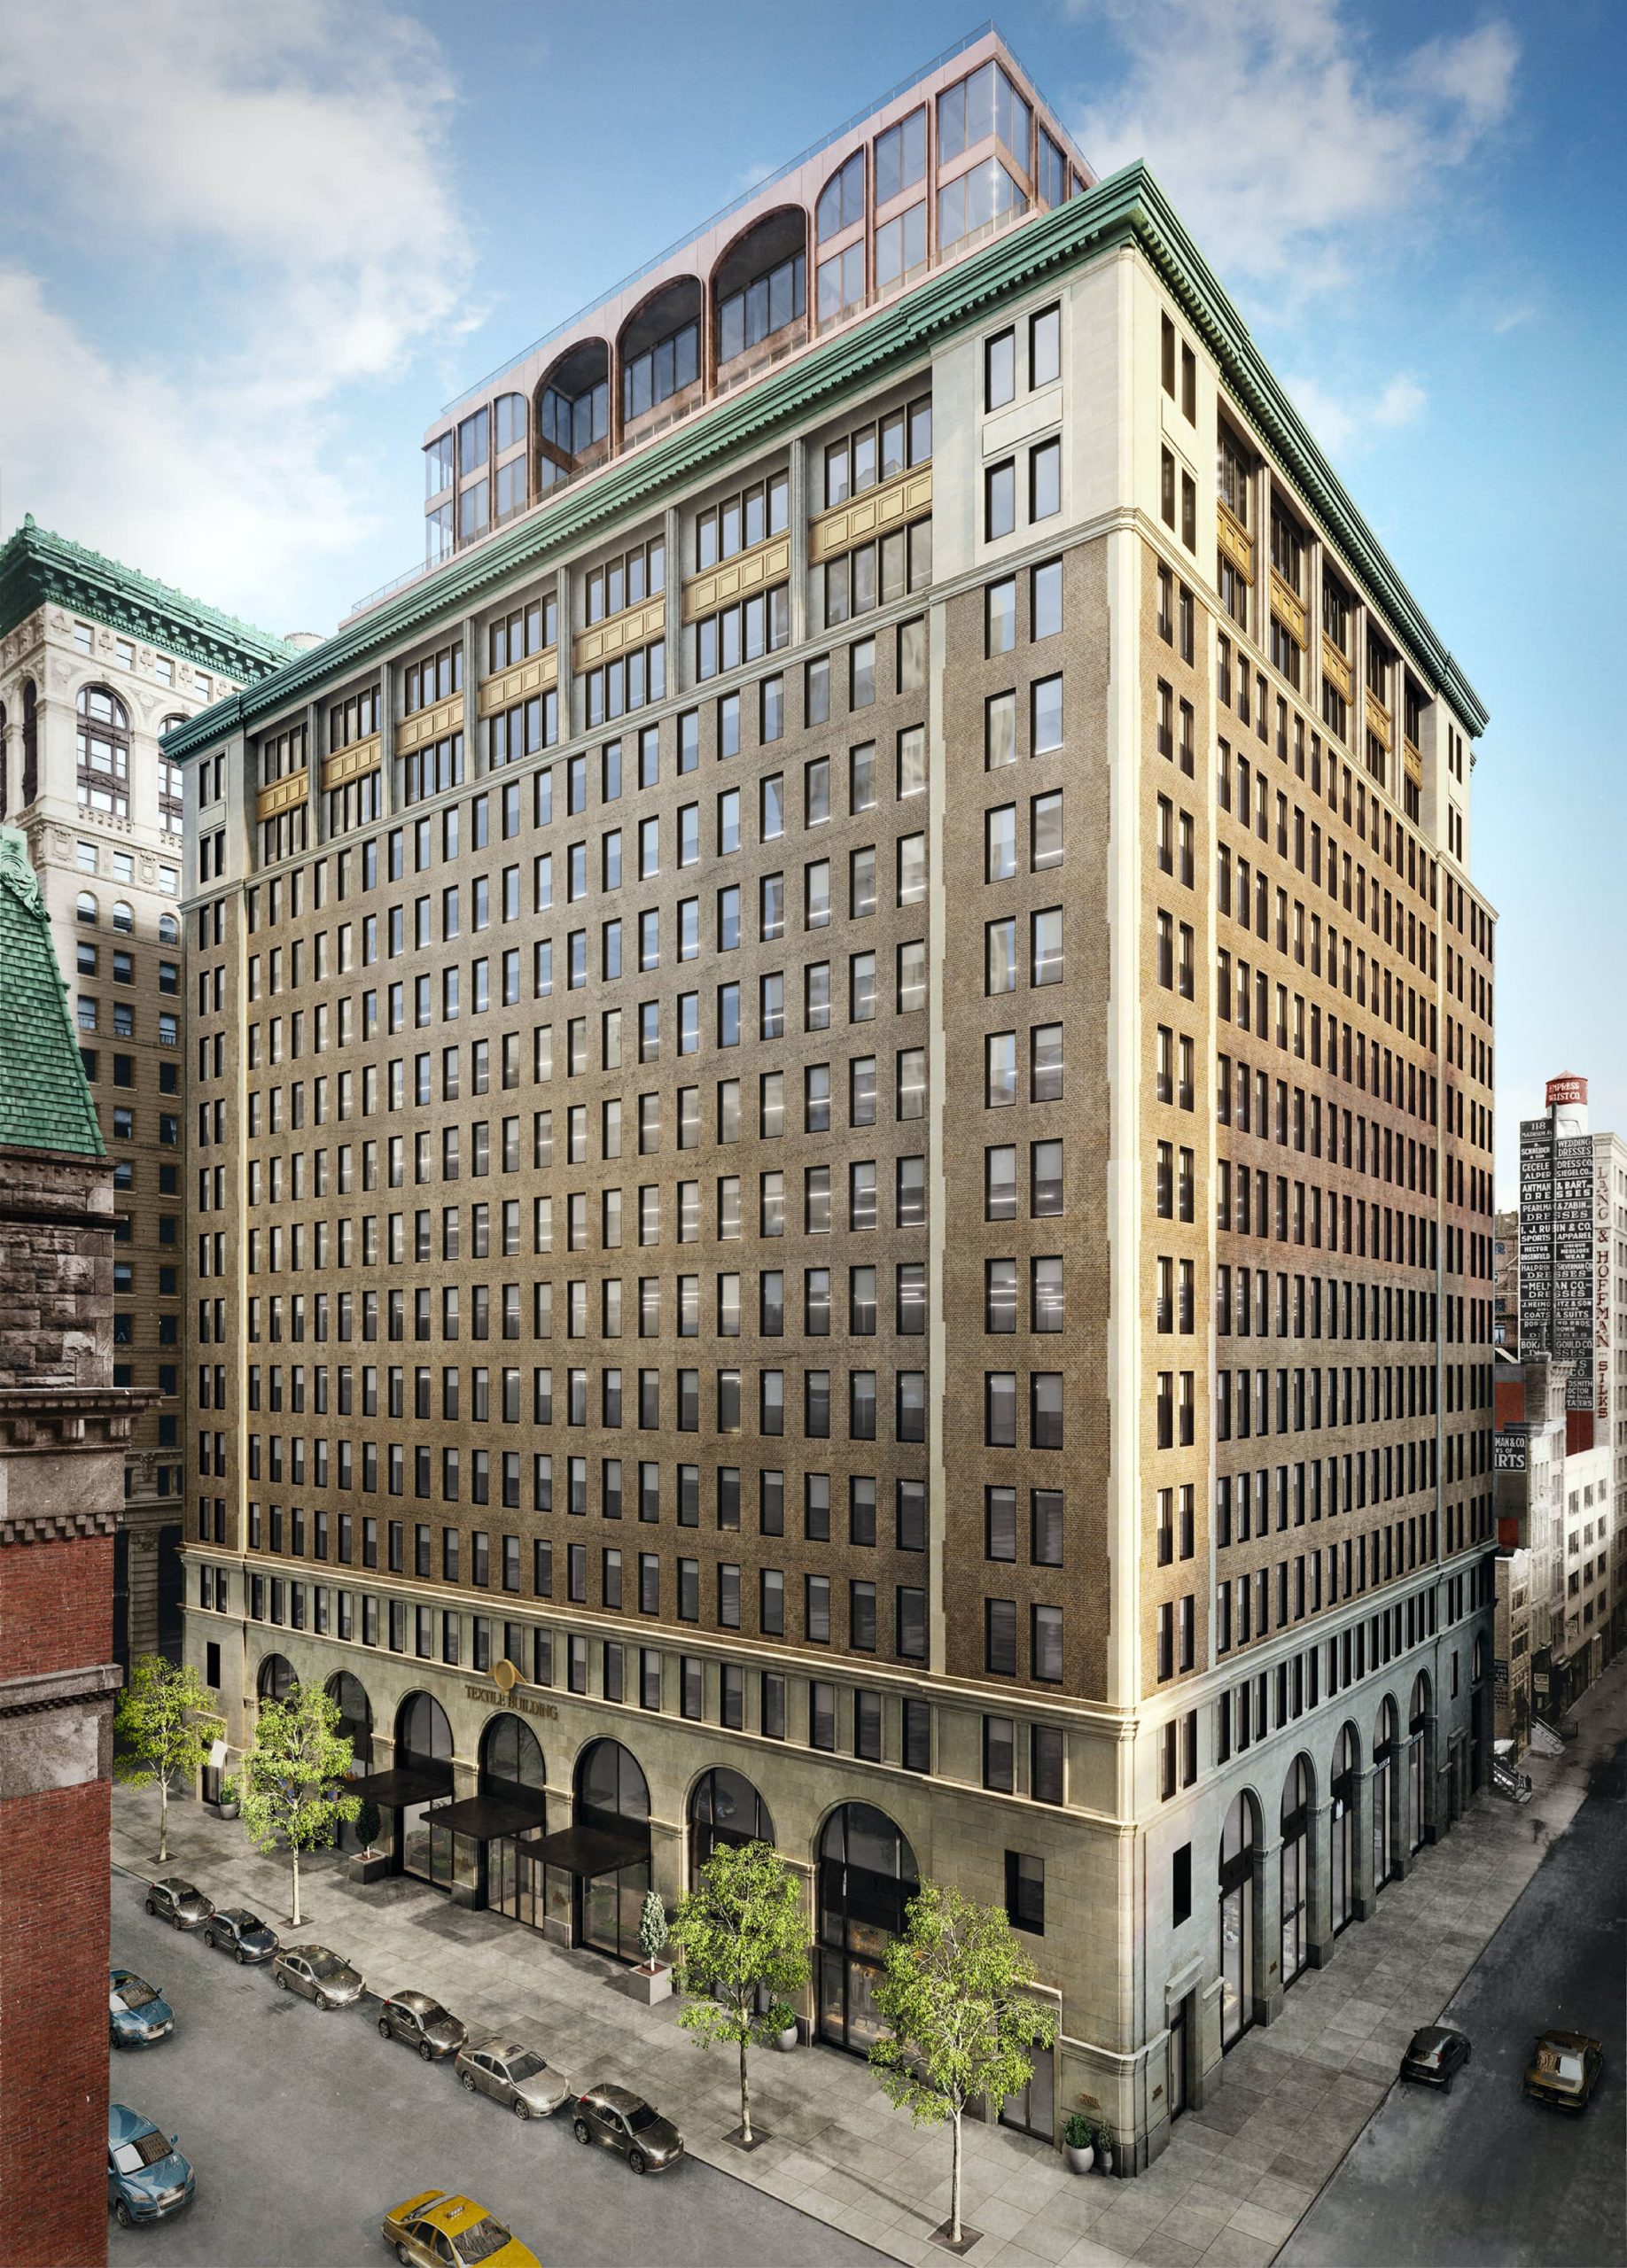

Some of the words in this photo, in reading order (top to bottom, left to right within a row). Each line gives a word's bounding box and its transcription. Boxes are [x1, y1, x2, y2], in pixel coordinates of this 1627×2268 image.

[1531, 1122, 1546, 1130] 118
[1558, 1138, 1591, 1148] WEDDING
[1558, 1146, 1592, 1157] DRESSES
[1522, 1162, 1550, 1172] CECELE
[1557, 1160, 1581, 1169] DRESS
[1524, 1171, 1552, 1180] ALPER
[1556, 1169, 1579, 1177] SIEGEL
[1565, 1180, 1587, 1190] BART
[1596, 1167, 1609, 1220] LANG
[1557, 1202, 1562, 1211] &
[1564, 1200, 1586, 1210] ZABIN
[1569, 1223, 1576, 1231] &
[1598, 1229, 1608, 1243] &
[1596, 1250, 1609, 1348] HOFFMAN
[1556, 1340, 1581, 1349] GOULD
[1597, 1361, 1608, 1418] SILKS
[1494, 1454, 1525, 1468] IRTS
[465, 1684, 506, 1707] TEXTILE
[508, 1693, 559, 1720] BUILDING
